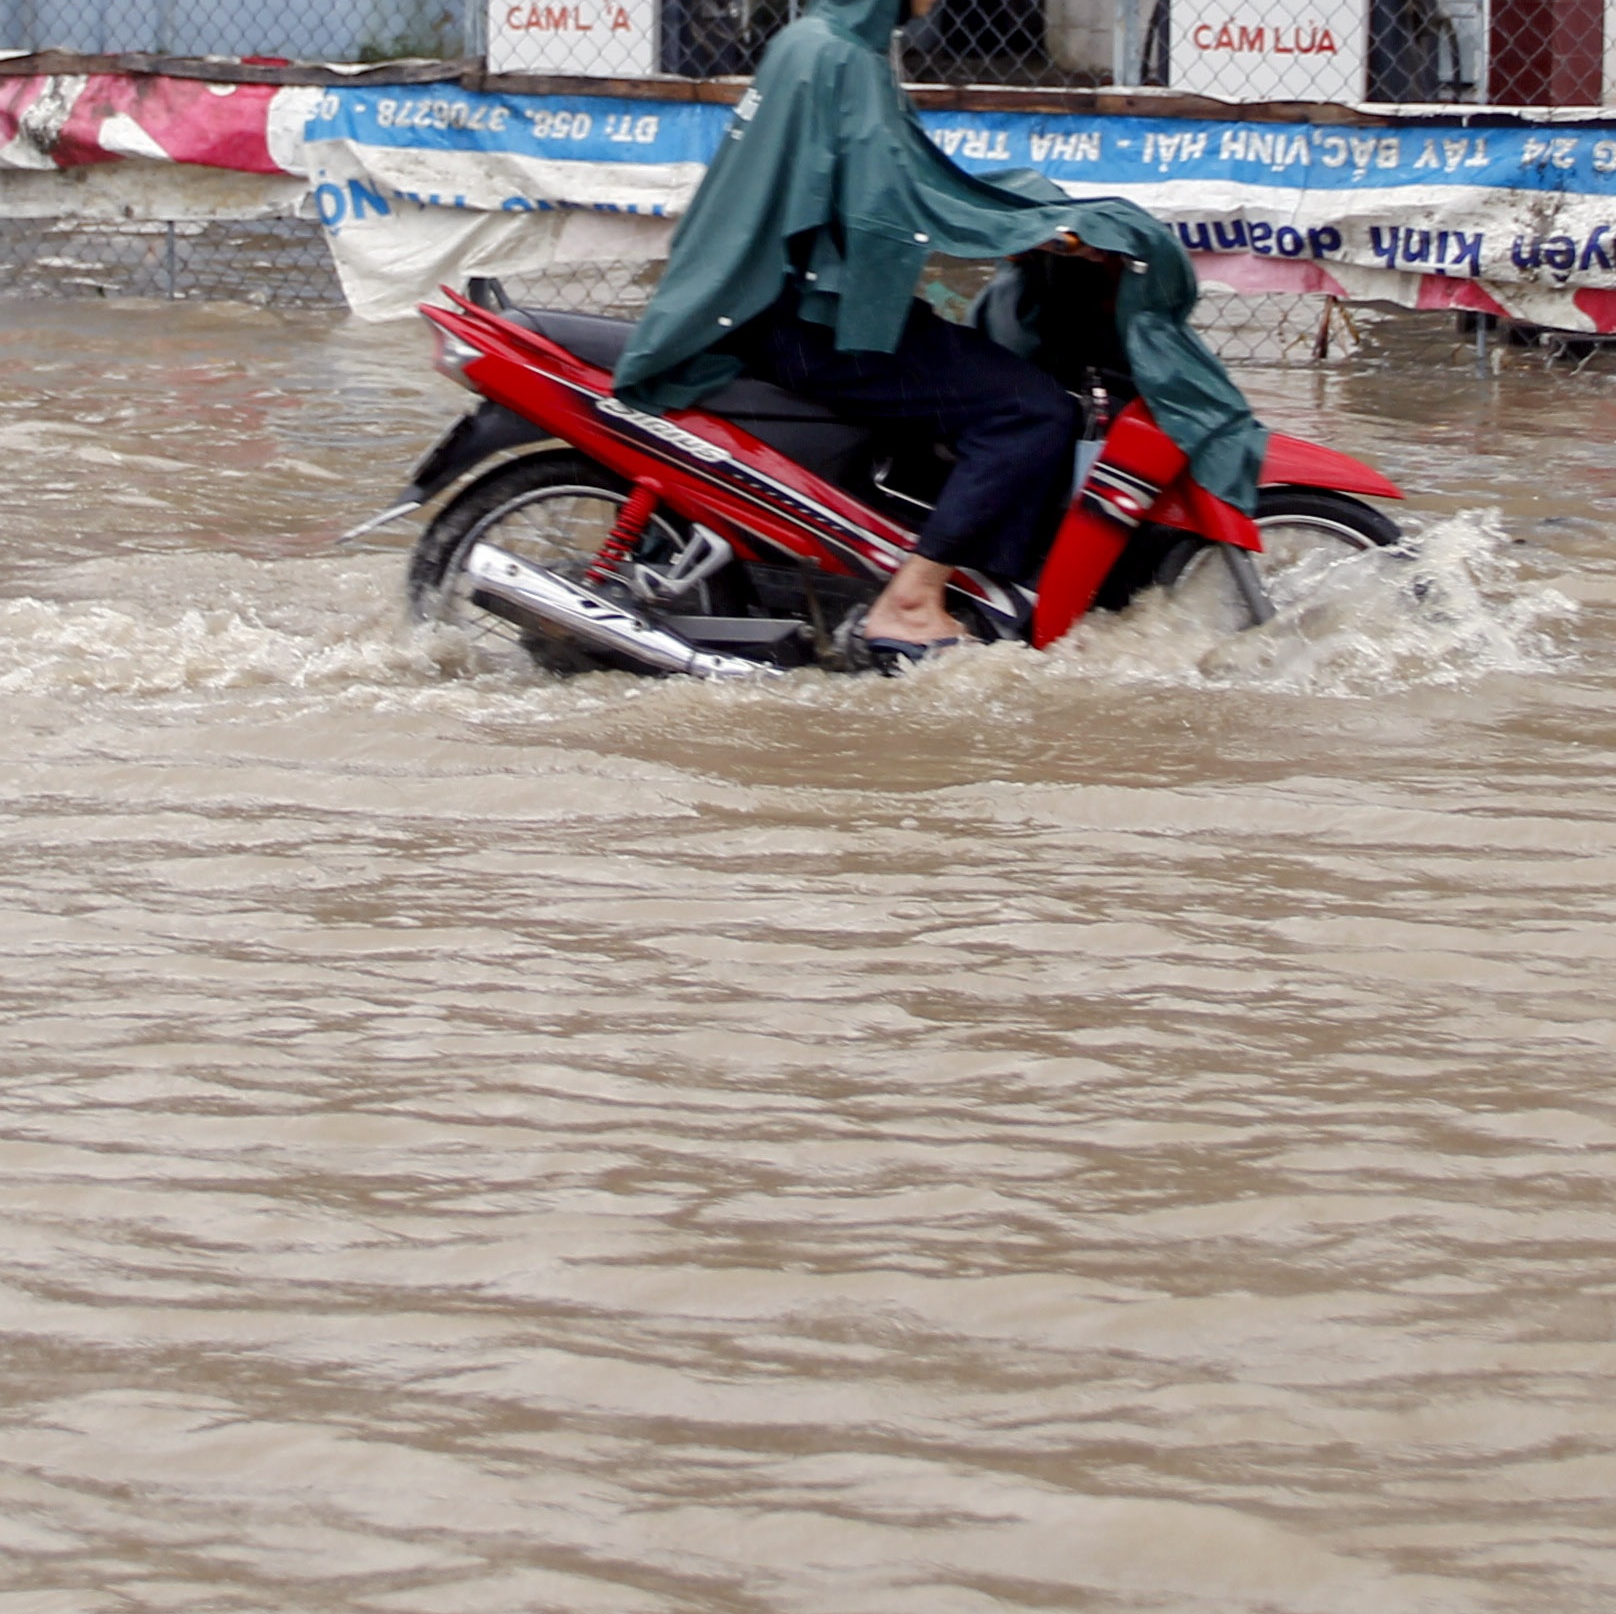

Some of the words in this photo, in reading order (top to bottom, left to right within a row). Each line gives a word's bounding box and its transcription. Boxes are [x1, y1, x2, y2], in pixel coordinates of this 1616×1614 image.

[604, 114, 660, 144] ĐT:
[1029, 130, 1102, 162] NHA
[1371, 226, 1484, 277] kinh
